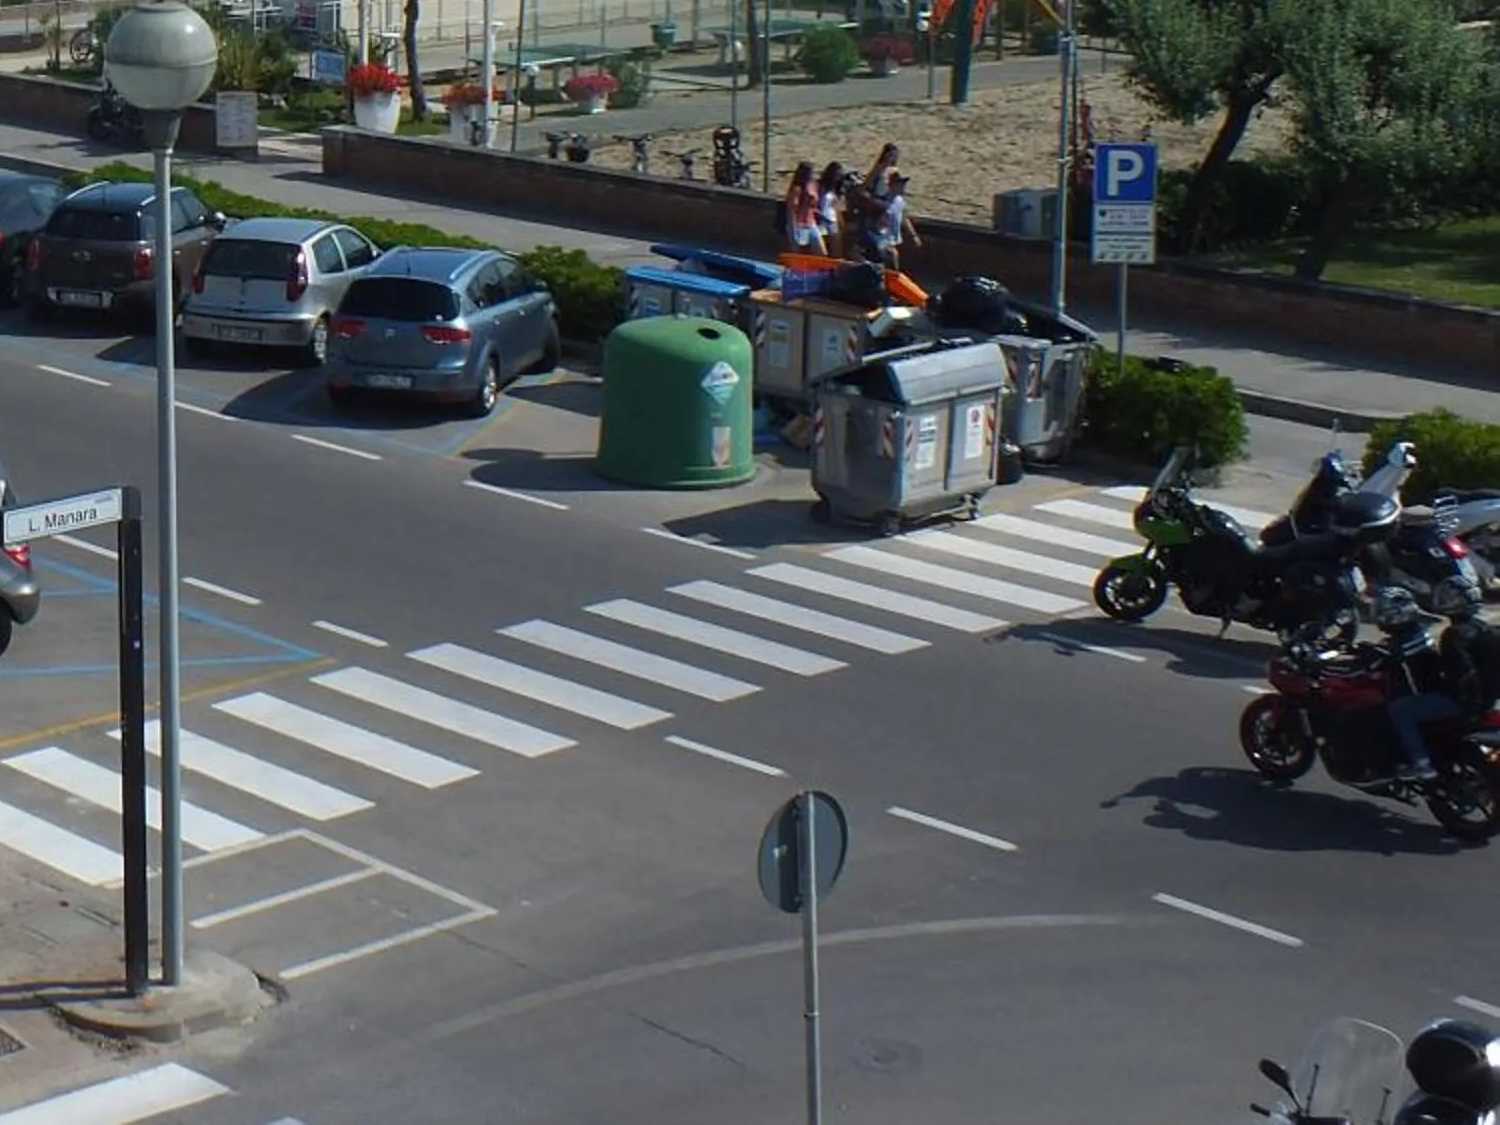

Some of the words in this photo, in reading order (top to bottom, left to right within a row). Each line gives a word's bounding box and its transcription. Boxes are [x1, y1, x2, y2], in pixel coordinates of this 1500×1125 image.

[1107, 150, 1144, 196] P
[28, 517, 41, 532] L.
[44, 506, 97, 528] Manara
